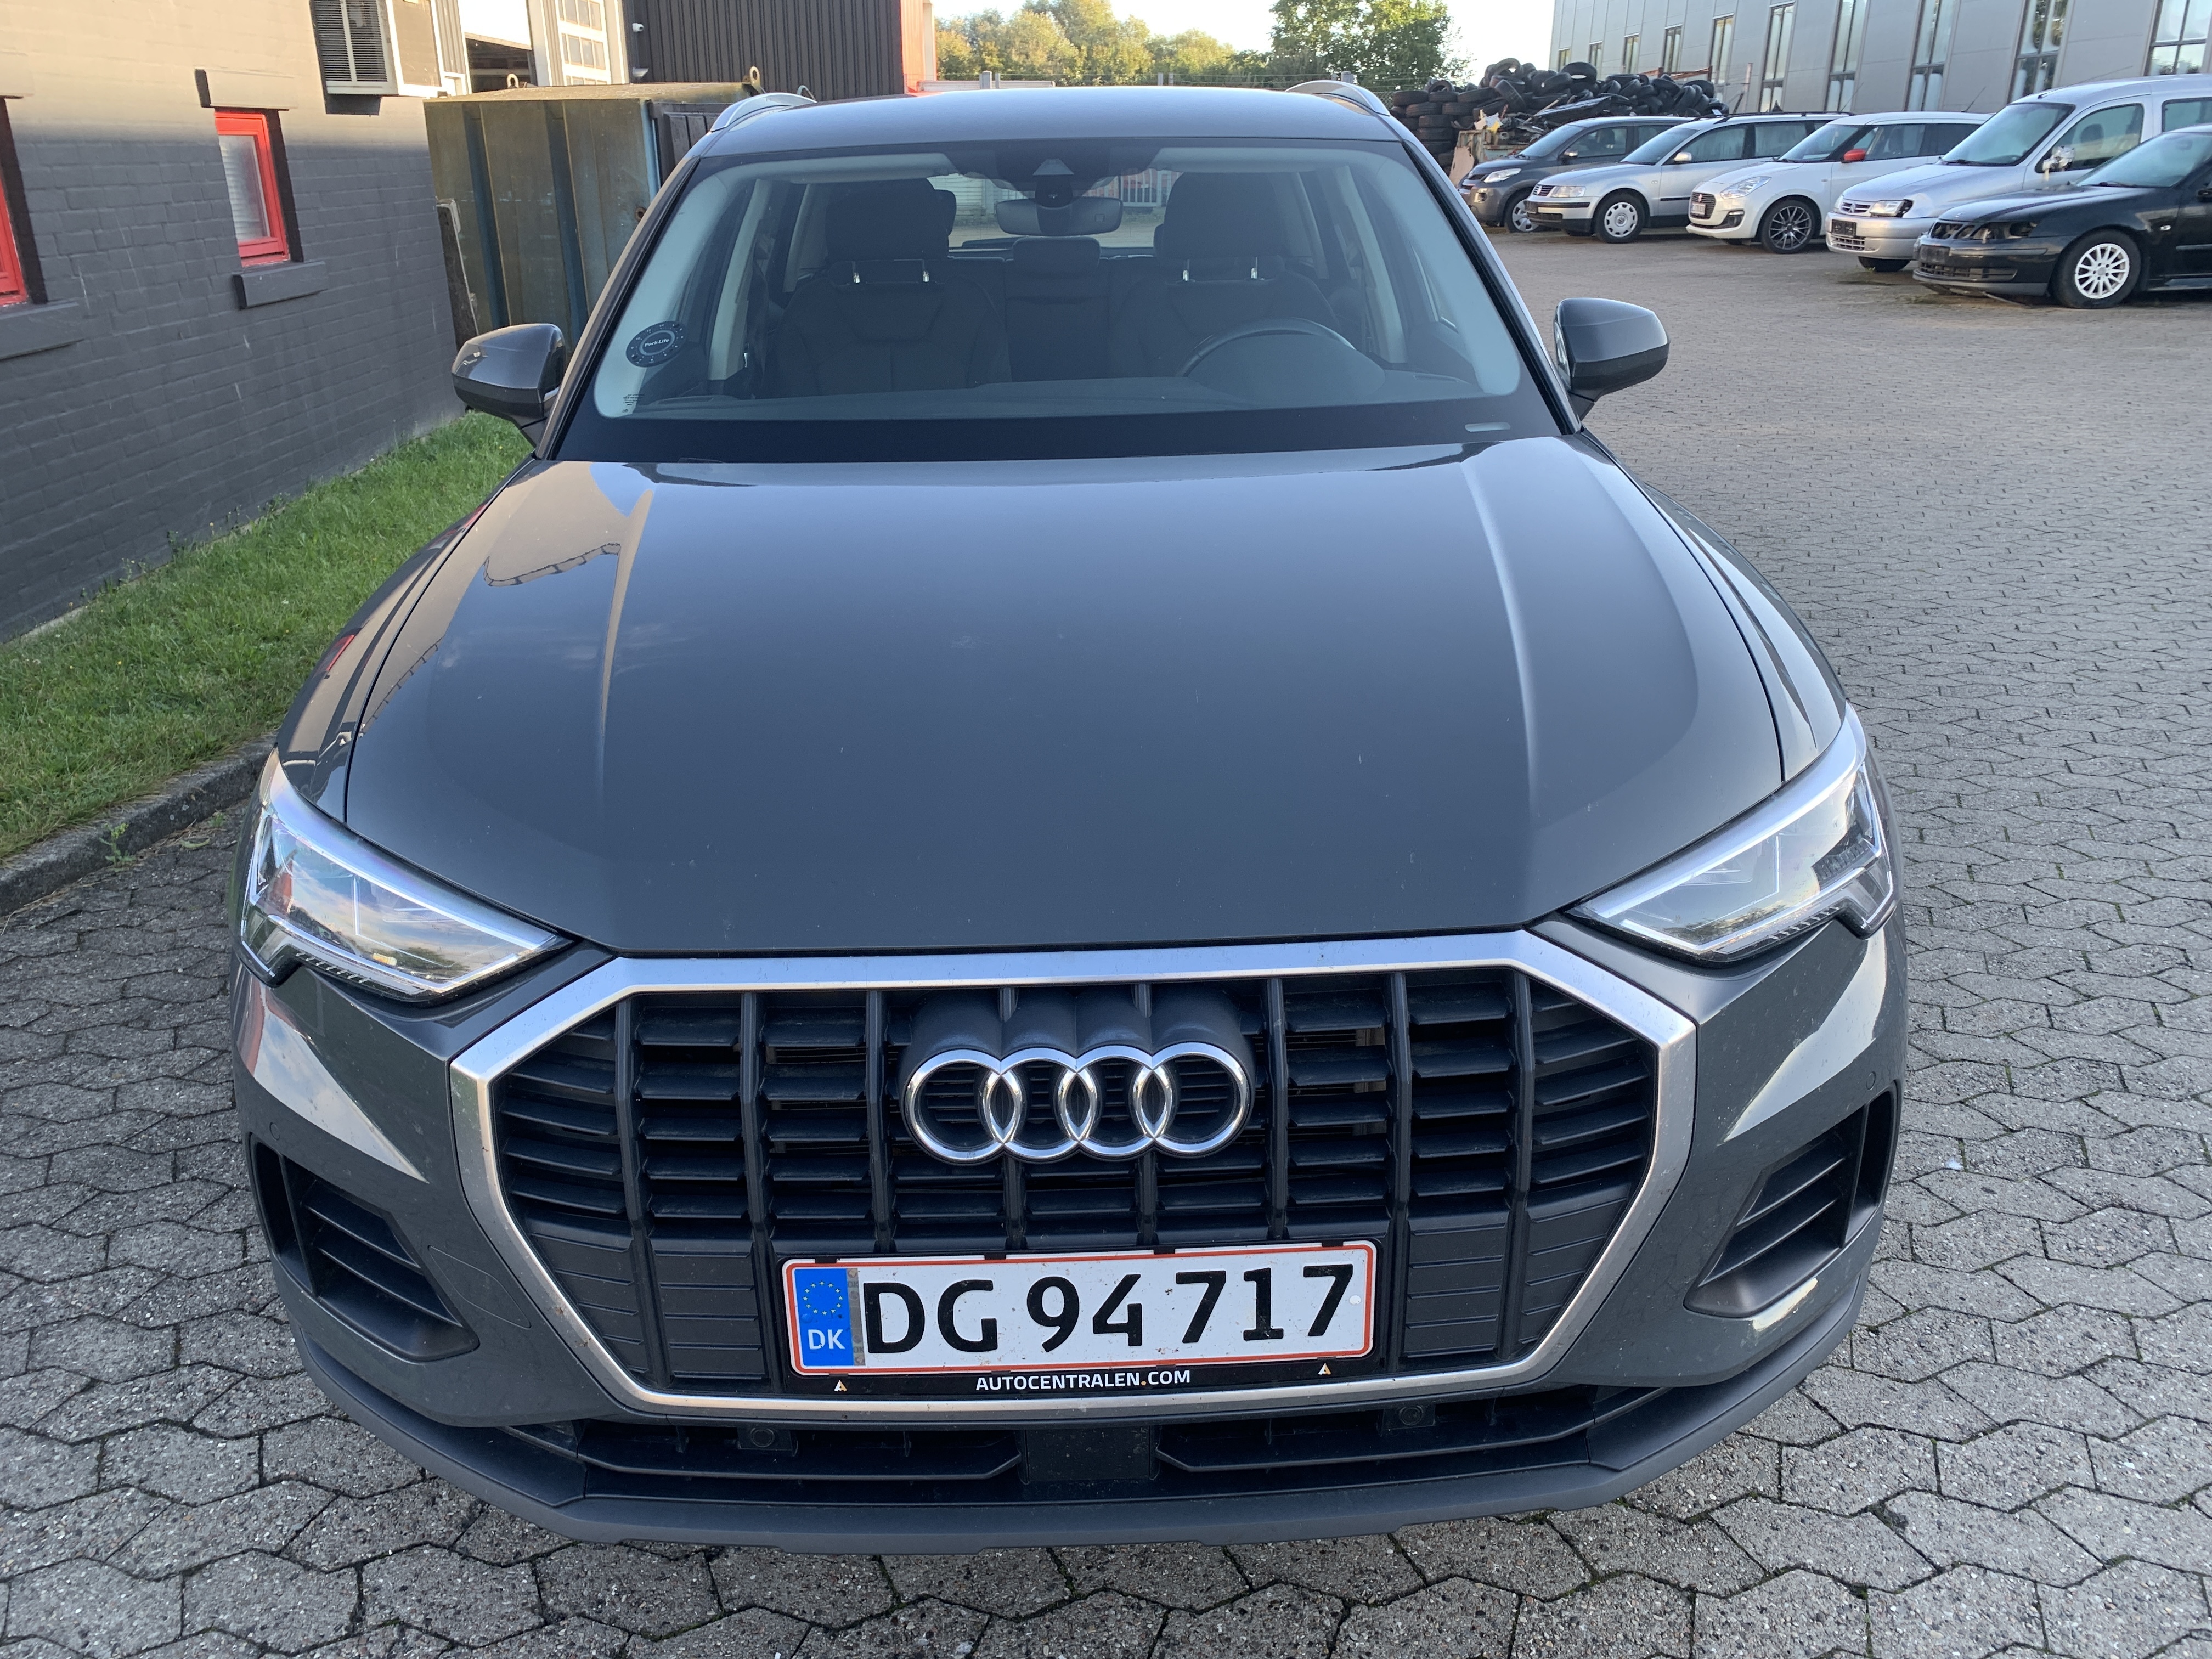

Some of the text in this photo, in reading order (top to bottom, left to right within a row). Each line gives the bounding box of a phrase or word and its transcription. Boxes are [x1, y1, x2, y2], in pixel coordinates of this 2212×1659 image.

[863, 1263, 1354, 1354] DG 94 717
[808, 1329, 846, 1350] DK
[975, 1370, 1190, 1391] AUTOCENTRALEN.COM
